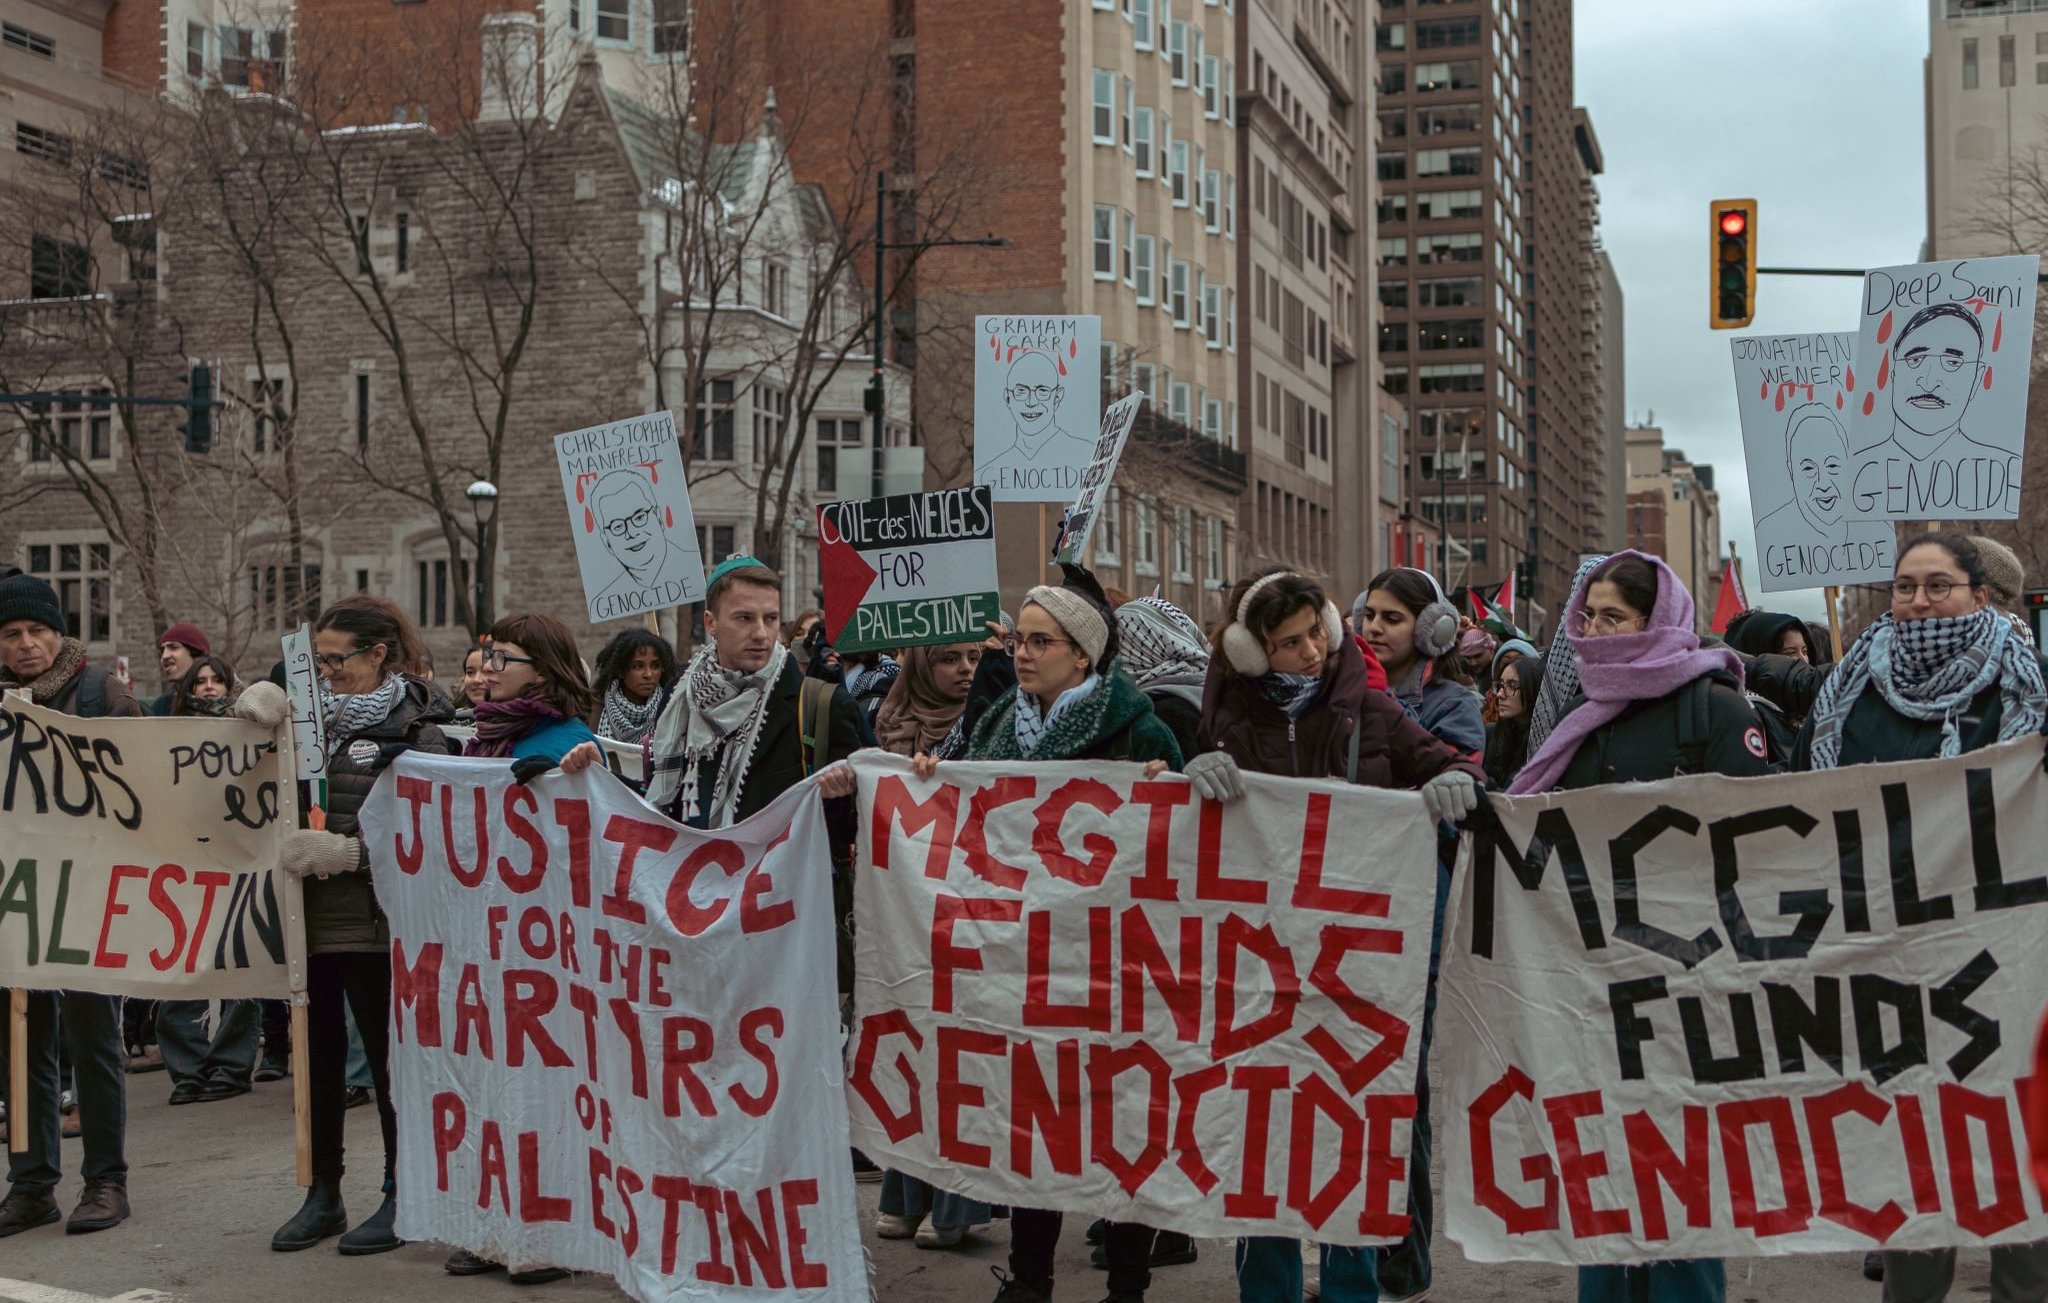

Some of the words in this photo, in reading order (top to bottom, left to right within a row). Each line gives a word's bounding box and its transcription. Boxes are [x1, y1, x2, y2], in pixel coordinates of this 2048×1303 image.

[1867, 270, 1941, 316] Deep
[1949, 261, 2022, 309] Saini
[984, 317, 1076, 336] GRAHAM
[1006, 335, 1063, 351] CARR
[1735, 334, 1851, 362] JONATHAN
[1760, 364, 1844, 388] WENER
[561, 417, 676, 456] CHRISTOPHER
[567, 443, 664, 476] MANFREDI
[1852, 456, 2021, 514] GENOCIDE
[879, 551, 926, 591] FOR
[1766, 540, 1892, 578] GENOCIDE
[596, 577, 701, 619] GENOCIDE
[857, 595, 986, 642] PALESTINE
[292, 653, 325, 774] فلسطين
[394, 775, 796, 937] JUSTICE
[871, 773, 1392, 918] MCGILL
[1471, 767, 2048, 970] MCGILL
[0, 859, 287, 974] ALESTIN
[486, 906, 581, 974] FOR
[593, 928, 672, 1007] THE
[929, 893, 1411, 1097] FUNDS
[1607, 948, 2002, 1087] FUNDS
[392, 938, 785, 1118] MARTYRS
[575, 1083, 613, 1145] OF
[848, 1008, 1418, 1238] GENOCIDE
[431, 1091, 828, 1289] PALESTINE
